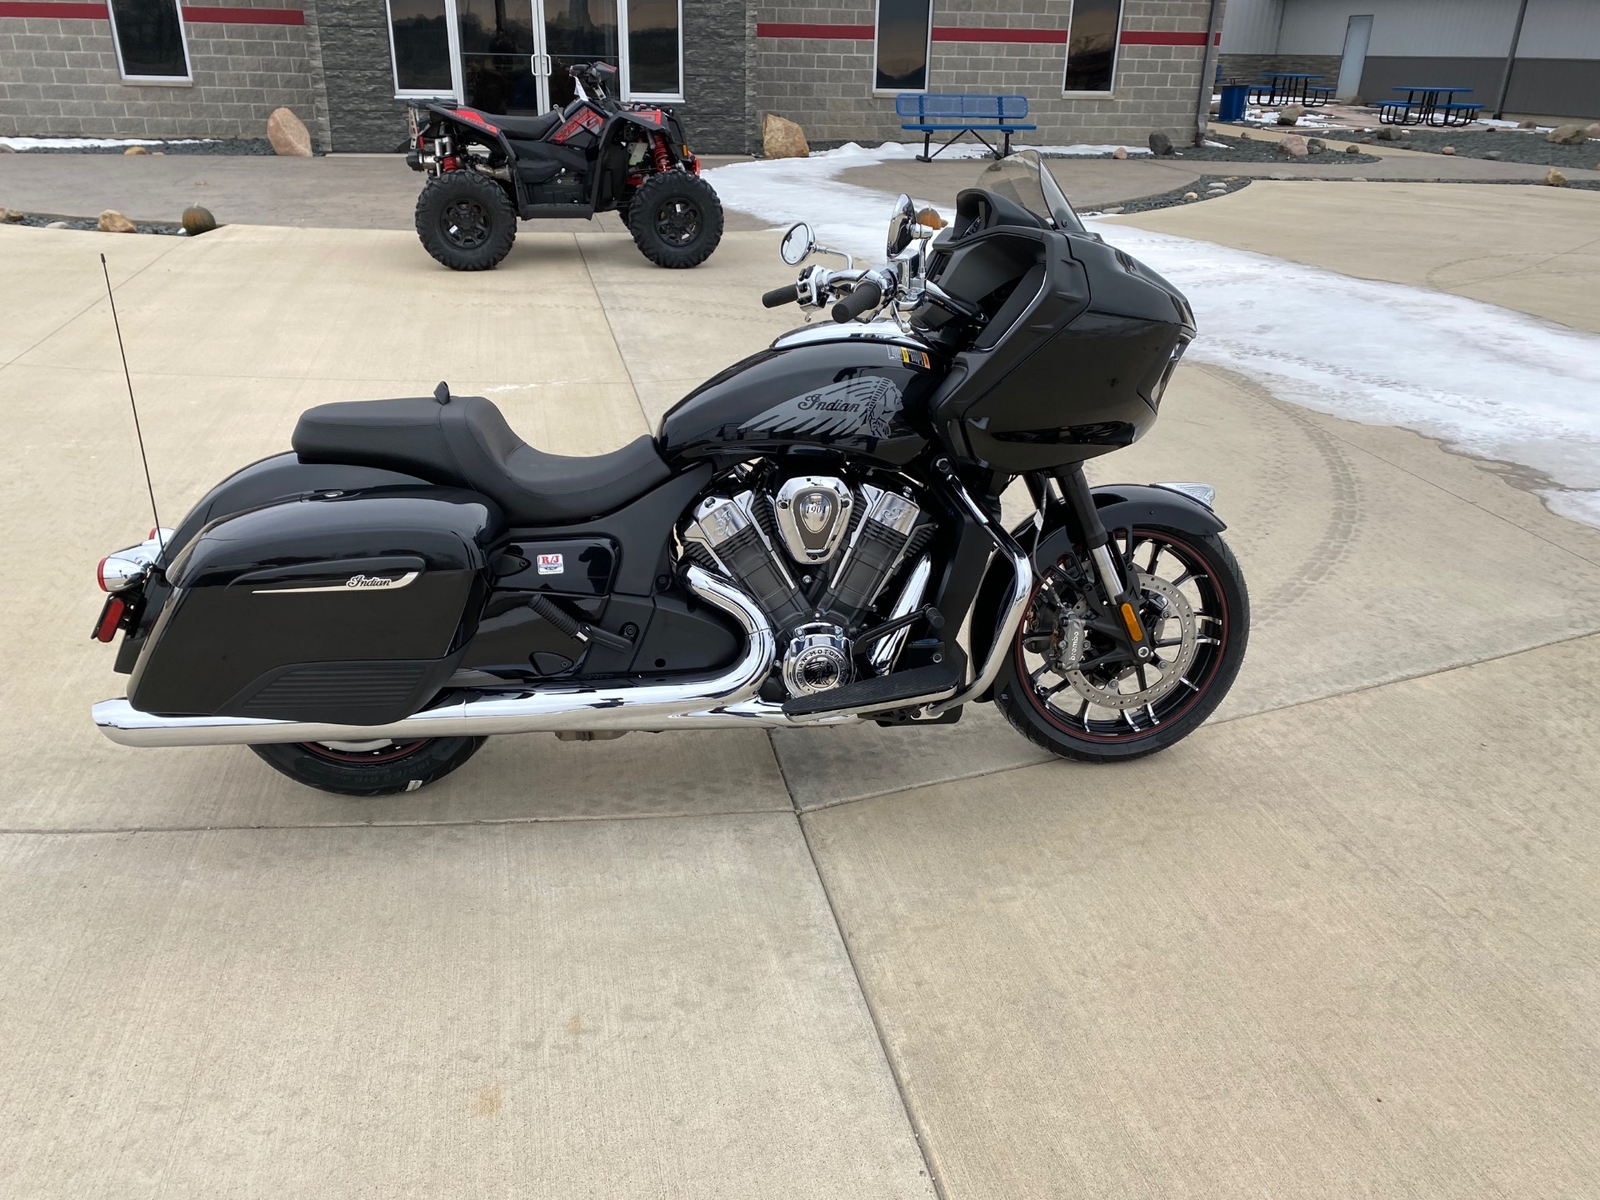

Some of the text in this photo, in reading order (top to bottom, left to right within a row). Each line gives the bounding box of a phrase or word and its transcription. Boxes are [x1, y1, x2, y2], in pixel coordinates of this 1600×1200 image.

[797, 393, 861, 413] Indian
[806, 505, 827, 514] 1901
[541, 555, 560, 565] R/J
[347, 575, 391, 588] Indian
[1068, 631, 1080, 661] brembo
